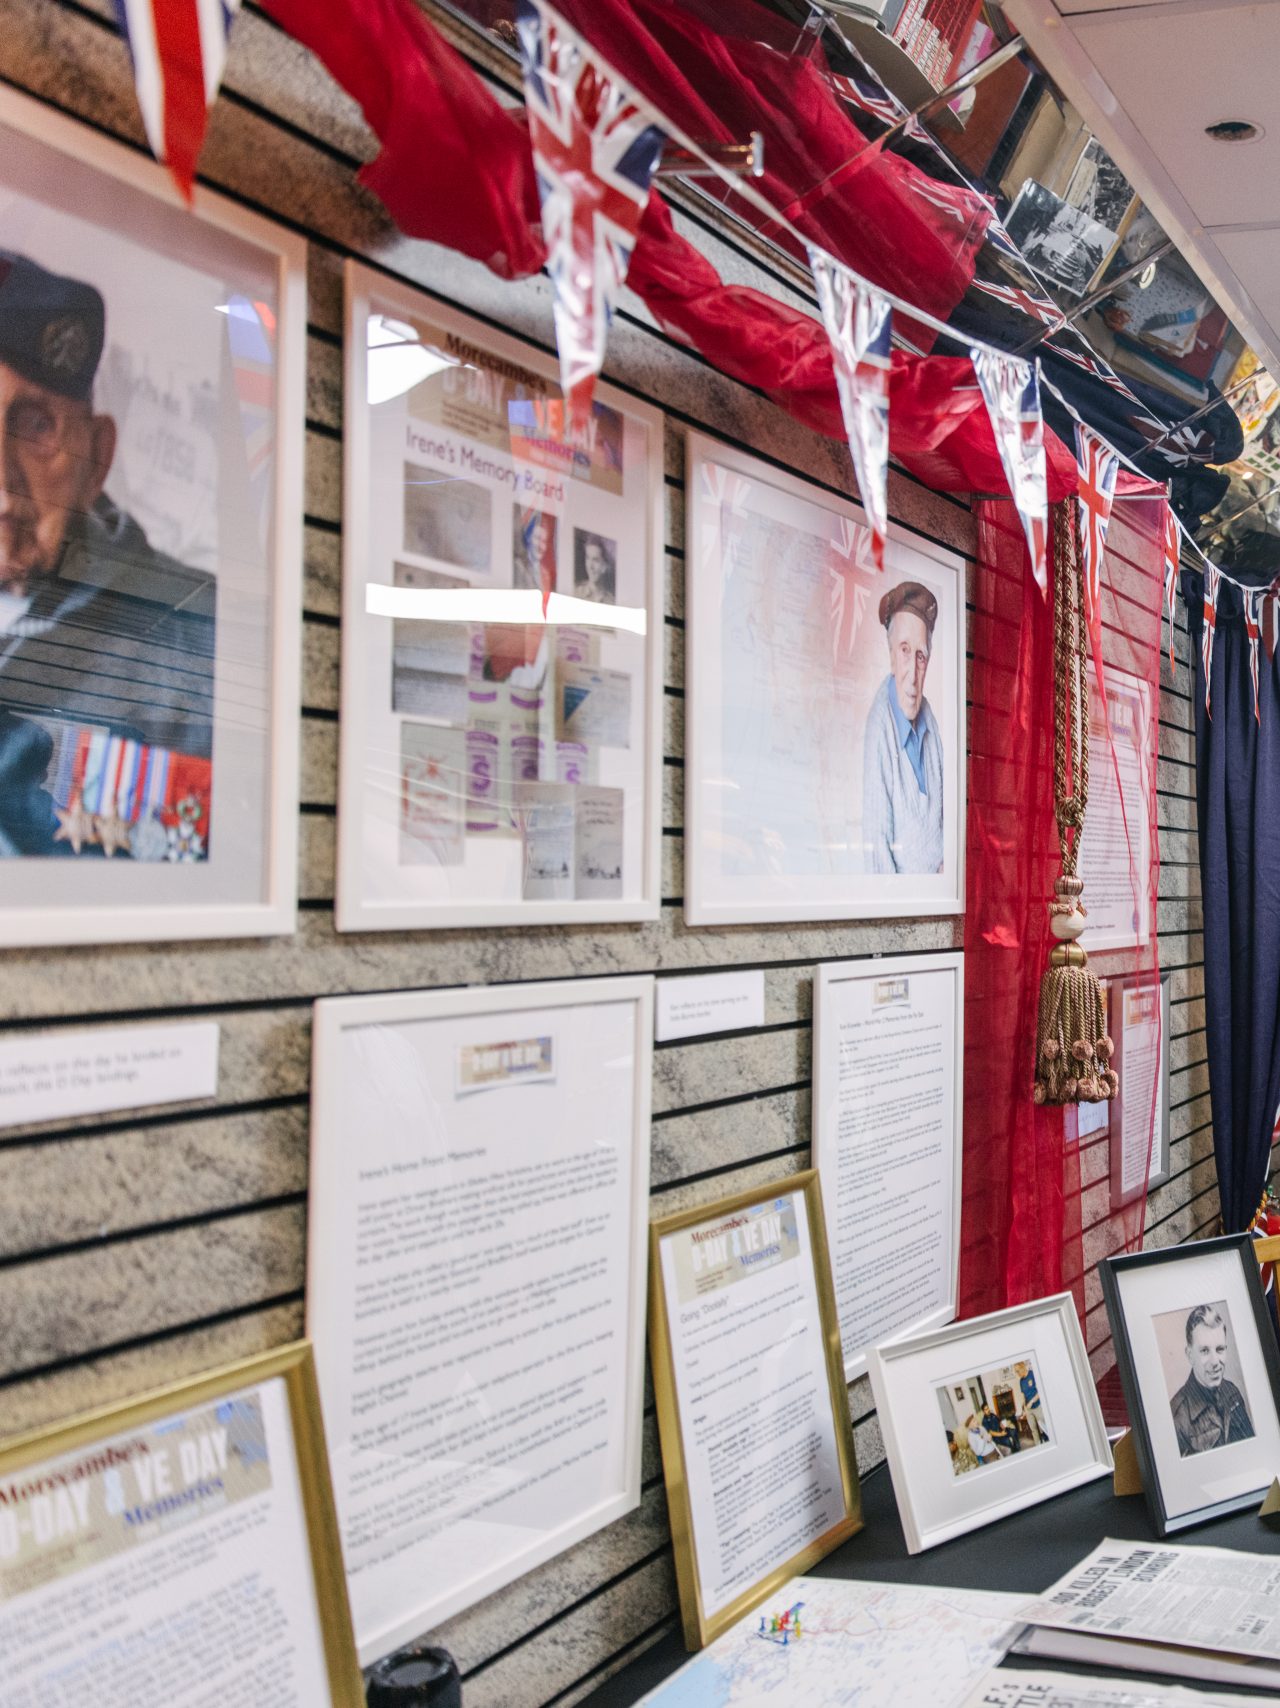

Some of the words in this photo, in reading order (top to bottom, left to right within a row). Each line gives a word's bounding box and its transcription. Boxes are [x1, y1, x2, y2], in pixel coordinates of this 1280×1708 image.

[445, 332, 548, 393] Morecambe's
[405, 425, 455, 464] Irene's
[459, 446, 520, 490] Memory
[524, 469, 564, 502] Board
[447, 1147, 487, 1164] Memories
[691, 1214, 750, 1244] Morecambe's
[739, 1243, 781, 1266] Memories
[0, 1439, 149, 1504] Morecambe's
[131, 1449, 173, 1502] VE
[178, 1428, 229, 1476] DAY
[124, 1476, 225, 1524] Memories
[1067, 1566, 1110, 1591] KILLED
[1097, 1556, 1122, 1565] IN
[1074, 1579, 1122, 1608] BIGGEST
[1107, 1549, 1155, 1579] LONDON
[1131, 1551, 1180, 1583] BOMBING
